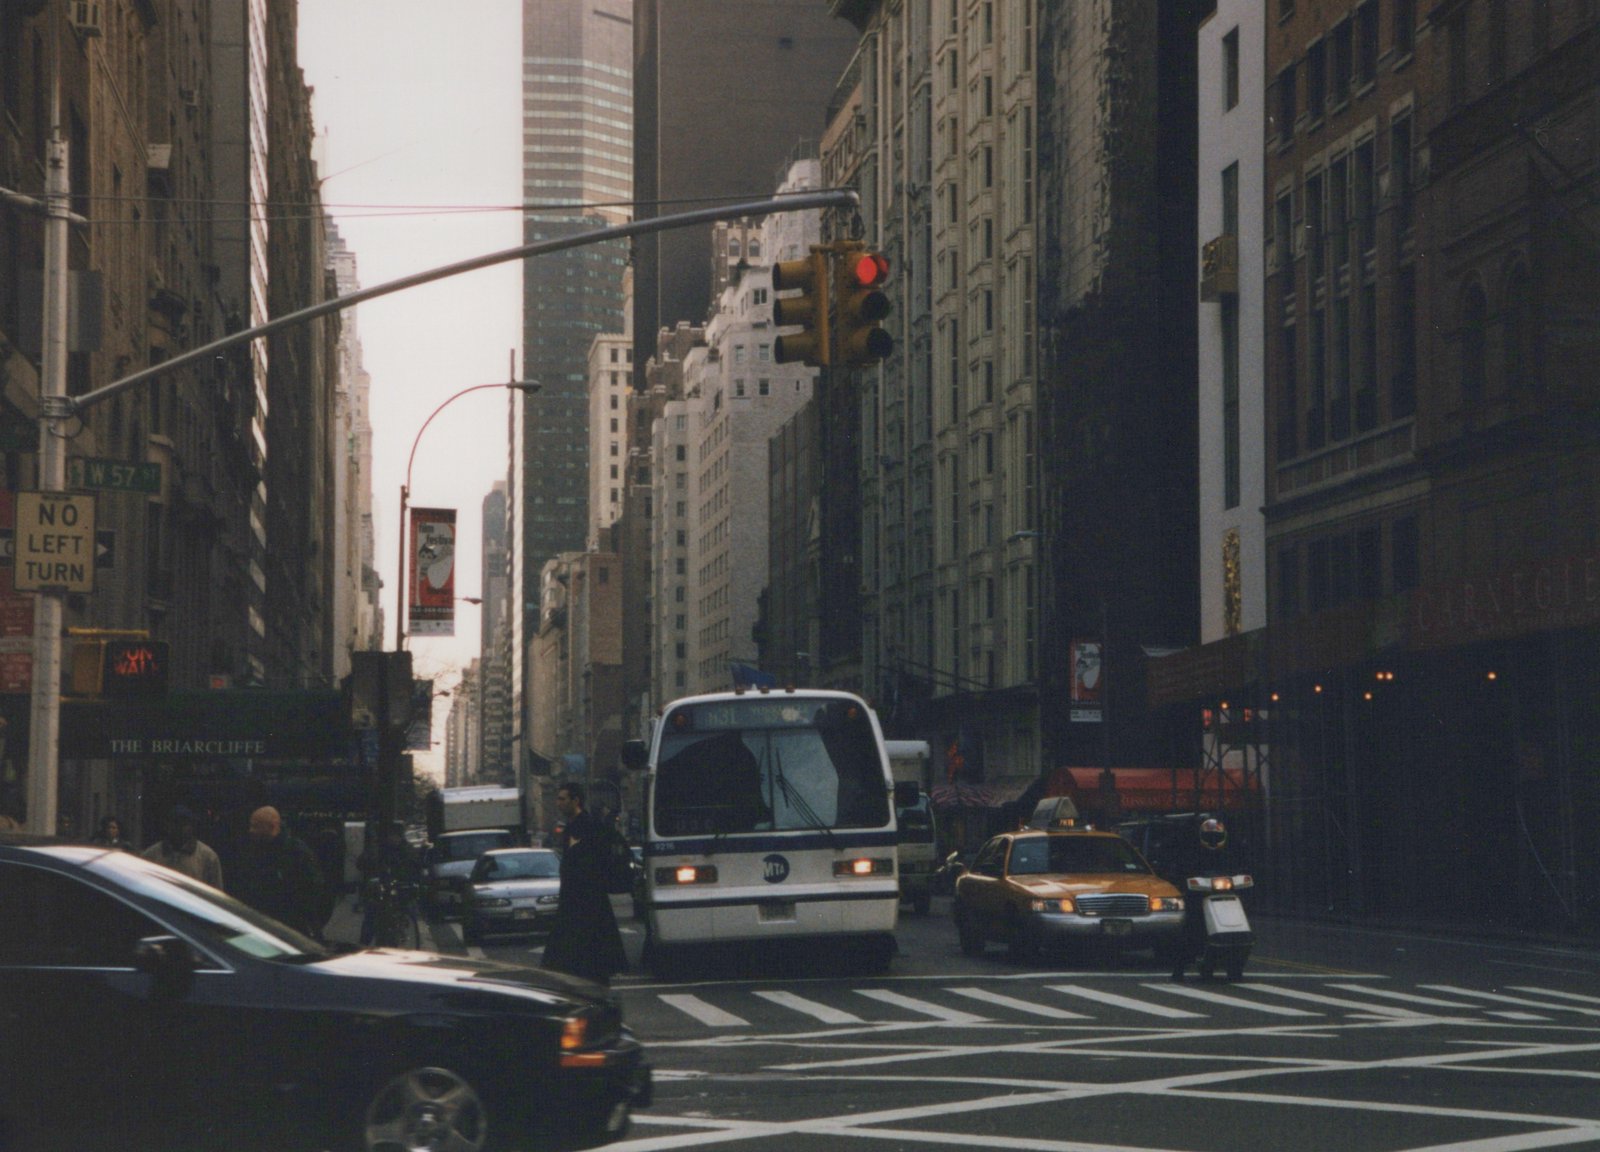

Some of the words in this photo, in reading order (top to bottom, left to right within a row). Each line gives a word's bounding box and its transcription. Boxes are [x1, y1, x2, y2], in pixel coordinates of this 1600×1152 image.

[90, 463, 105, 485] W
[111, 464, 135, 487] 57
[38, 503, 78, 527] NO
[28, 534, 83, 555] LEFT
[25, 561, 84, 583] TURN
[110, 740, 142, 753] THE
[152, 740, 264, 754] BRIARCLIFFE
